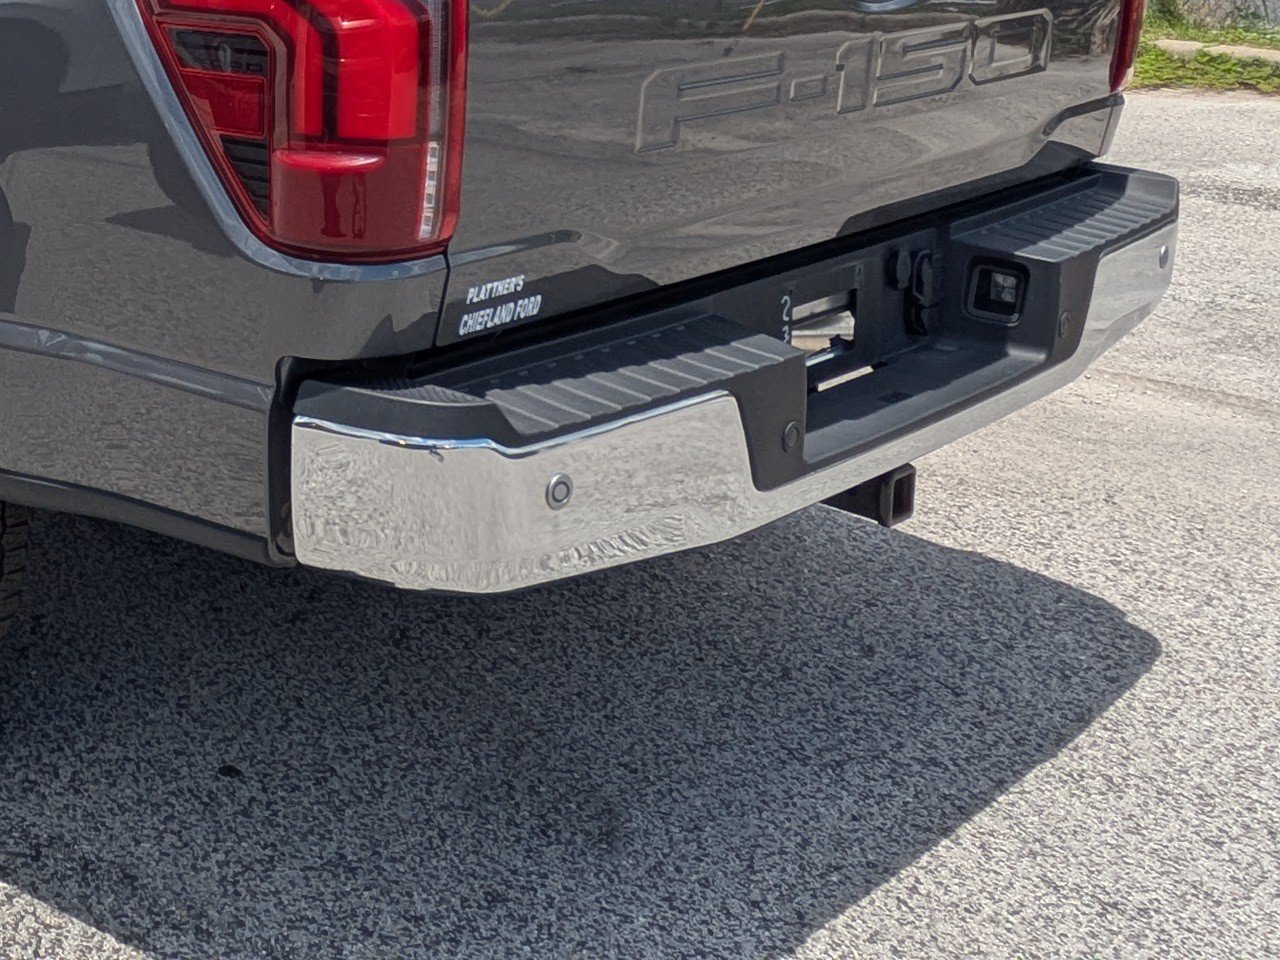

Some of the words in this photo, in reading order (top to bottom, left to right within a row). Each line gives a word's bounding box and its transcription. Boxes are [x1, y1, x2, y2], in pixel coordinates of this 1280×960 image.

[636, 8, 1053, 154] F-150
[466, 274, 525, 305] PLATTNER'S
[459, 302, 515, 336] CHIEFLAND
[514, 295, 542, 321] FORD
